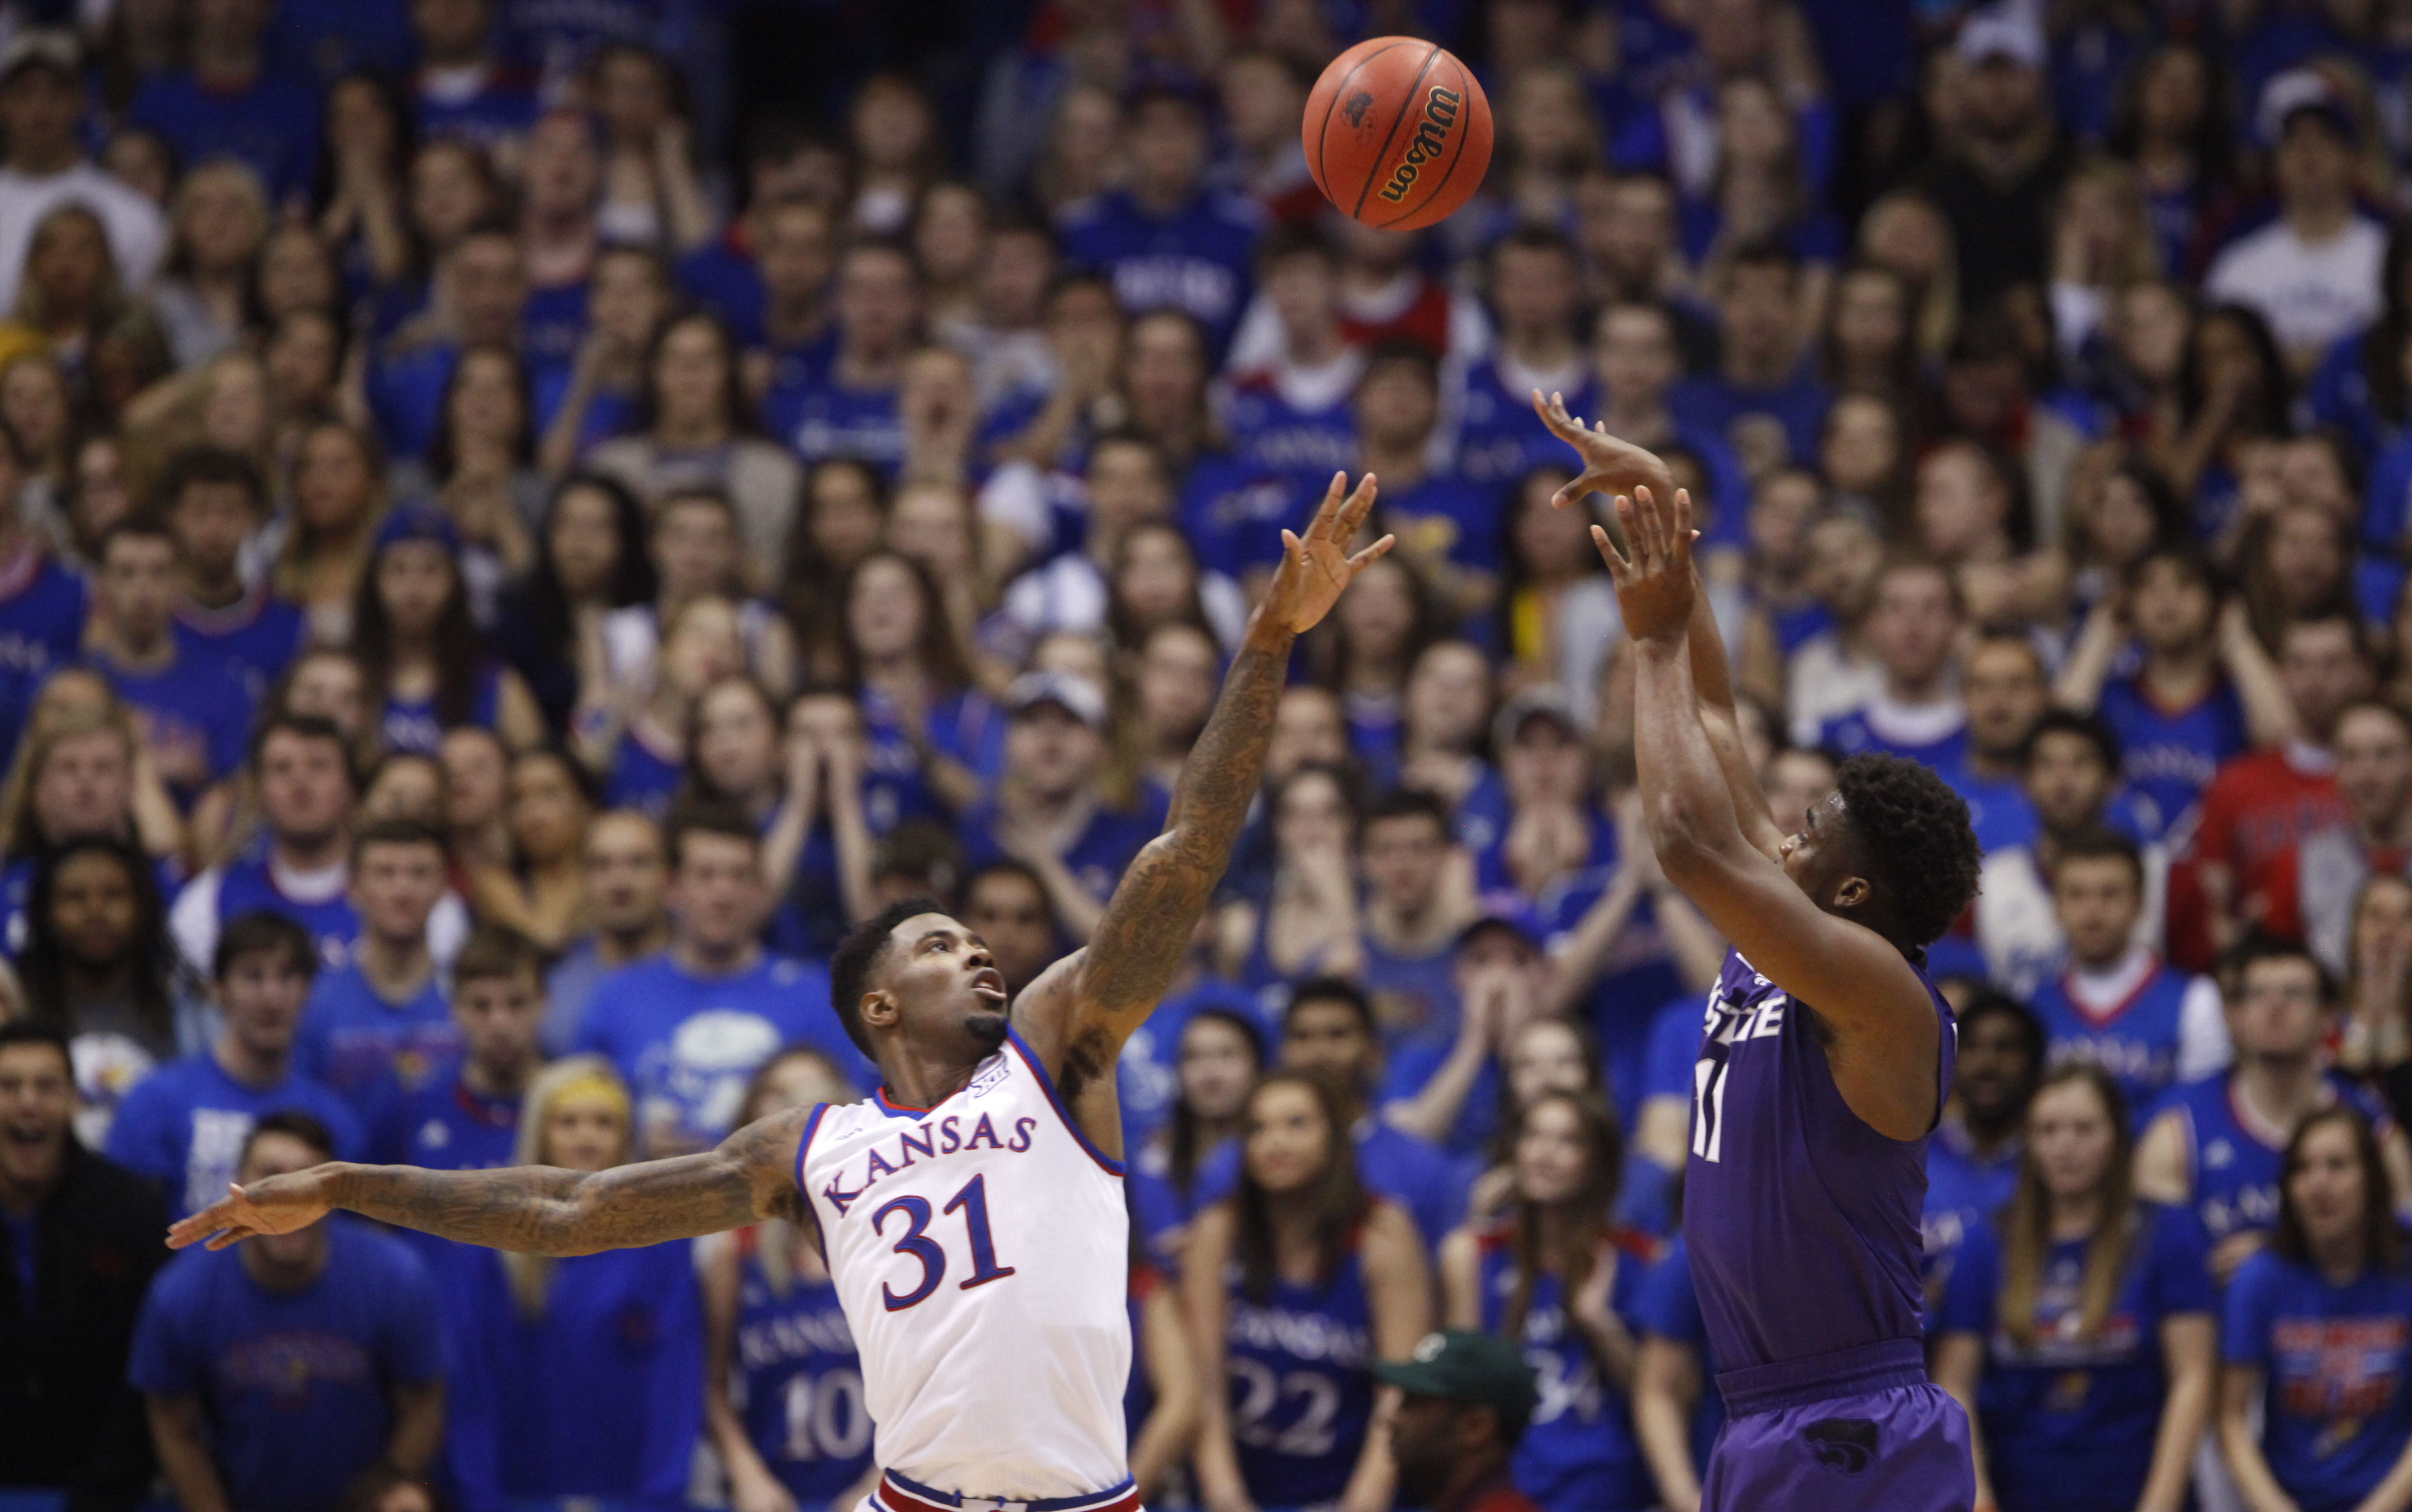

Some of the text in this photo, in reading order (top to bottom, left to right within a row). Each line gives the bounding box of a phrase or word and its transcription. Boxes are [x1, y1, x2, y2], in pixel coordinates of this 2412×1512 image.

[1378, 85, 1461, 203] Wilson
[1703, 989, 1788, 1047] STTE
[1693, 1058, 1729, 1163] 11
[823, 1112, 1037, 1219] KANSAS
[872, 1173, 1015, 1312] 31
[739, 1306, 859, 1371] KANS
[779, 1369, 873, 1461] 10
[1229, 1354, 1340, 1456] 22
